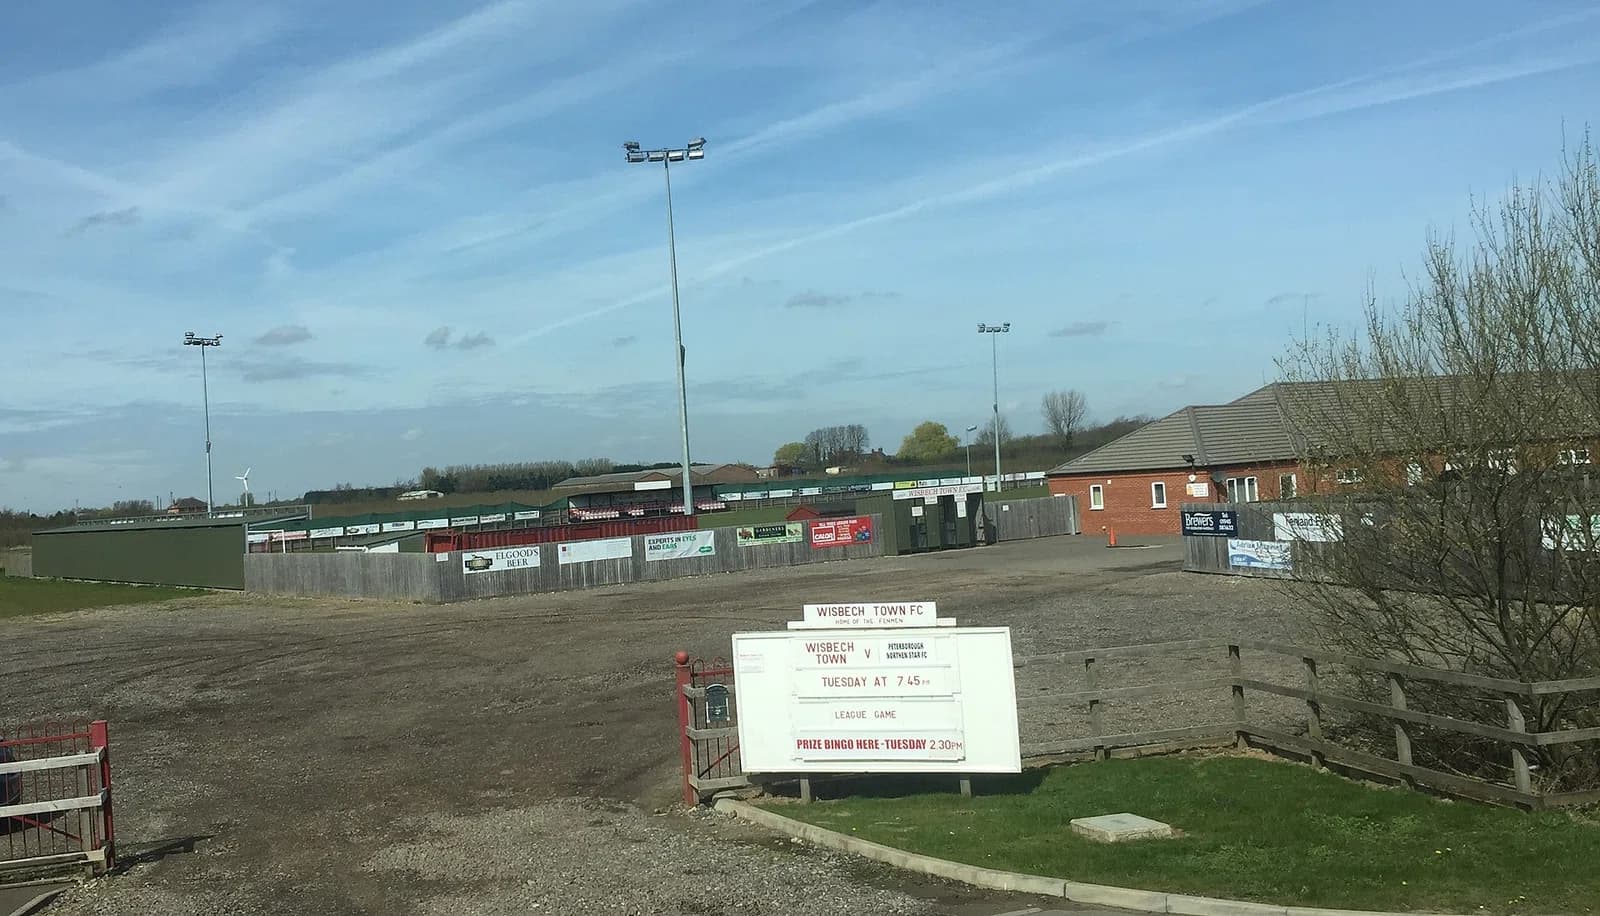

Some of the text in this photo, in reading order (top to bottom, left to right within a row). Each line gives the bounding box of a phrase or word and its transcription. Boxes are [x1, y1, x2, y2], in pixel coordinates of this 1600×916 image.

[909, 488, 937, 497] WISBECH
[940, 487, 958, 495] TOWN
[1184, 513, 1214, 526] Brewers
[682, 534, 696, 542] EYES
[496, 548, 539, 560] ELGOOD'S
[506, 558, 529, 568] BEER
[816, 605, 924, 617] WISBECH TOWN FC
[805, 642, 854, 652] WISBECH
[888, 642, 924, 650] PETERBOROUGH
[816, 654, 847, 664] TOWN
[822, 676, 867, 687] TUESDAY
[874, 676, 888, 687] AT
[835, 710, 896, 719] LEAGUE GAME
[797, 739, 822, 750] PRIZE
[824, 739, 854, 750] BINGO
